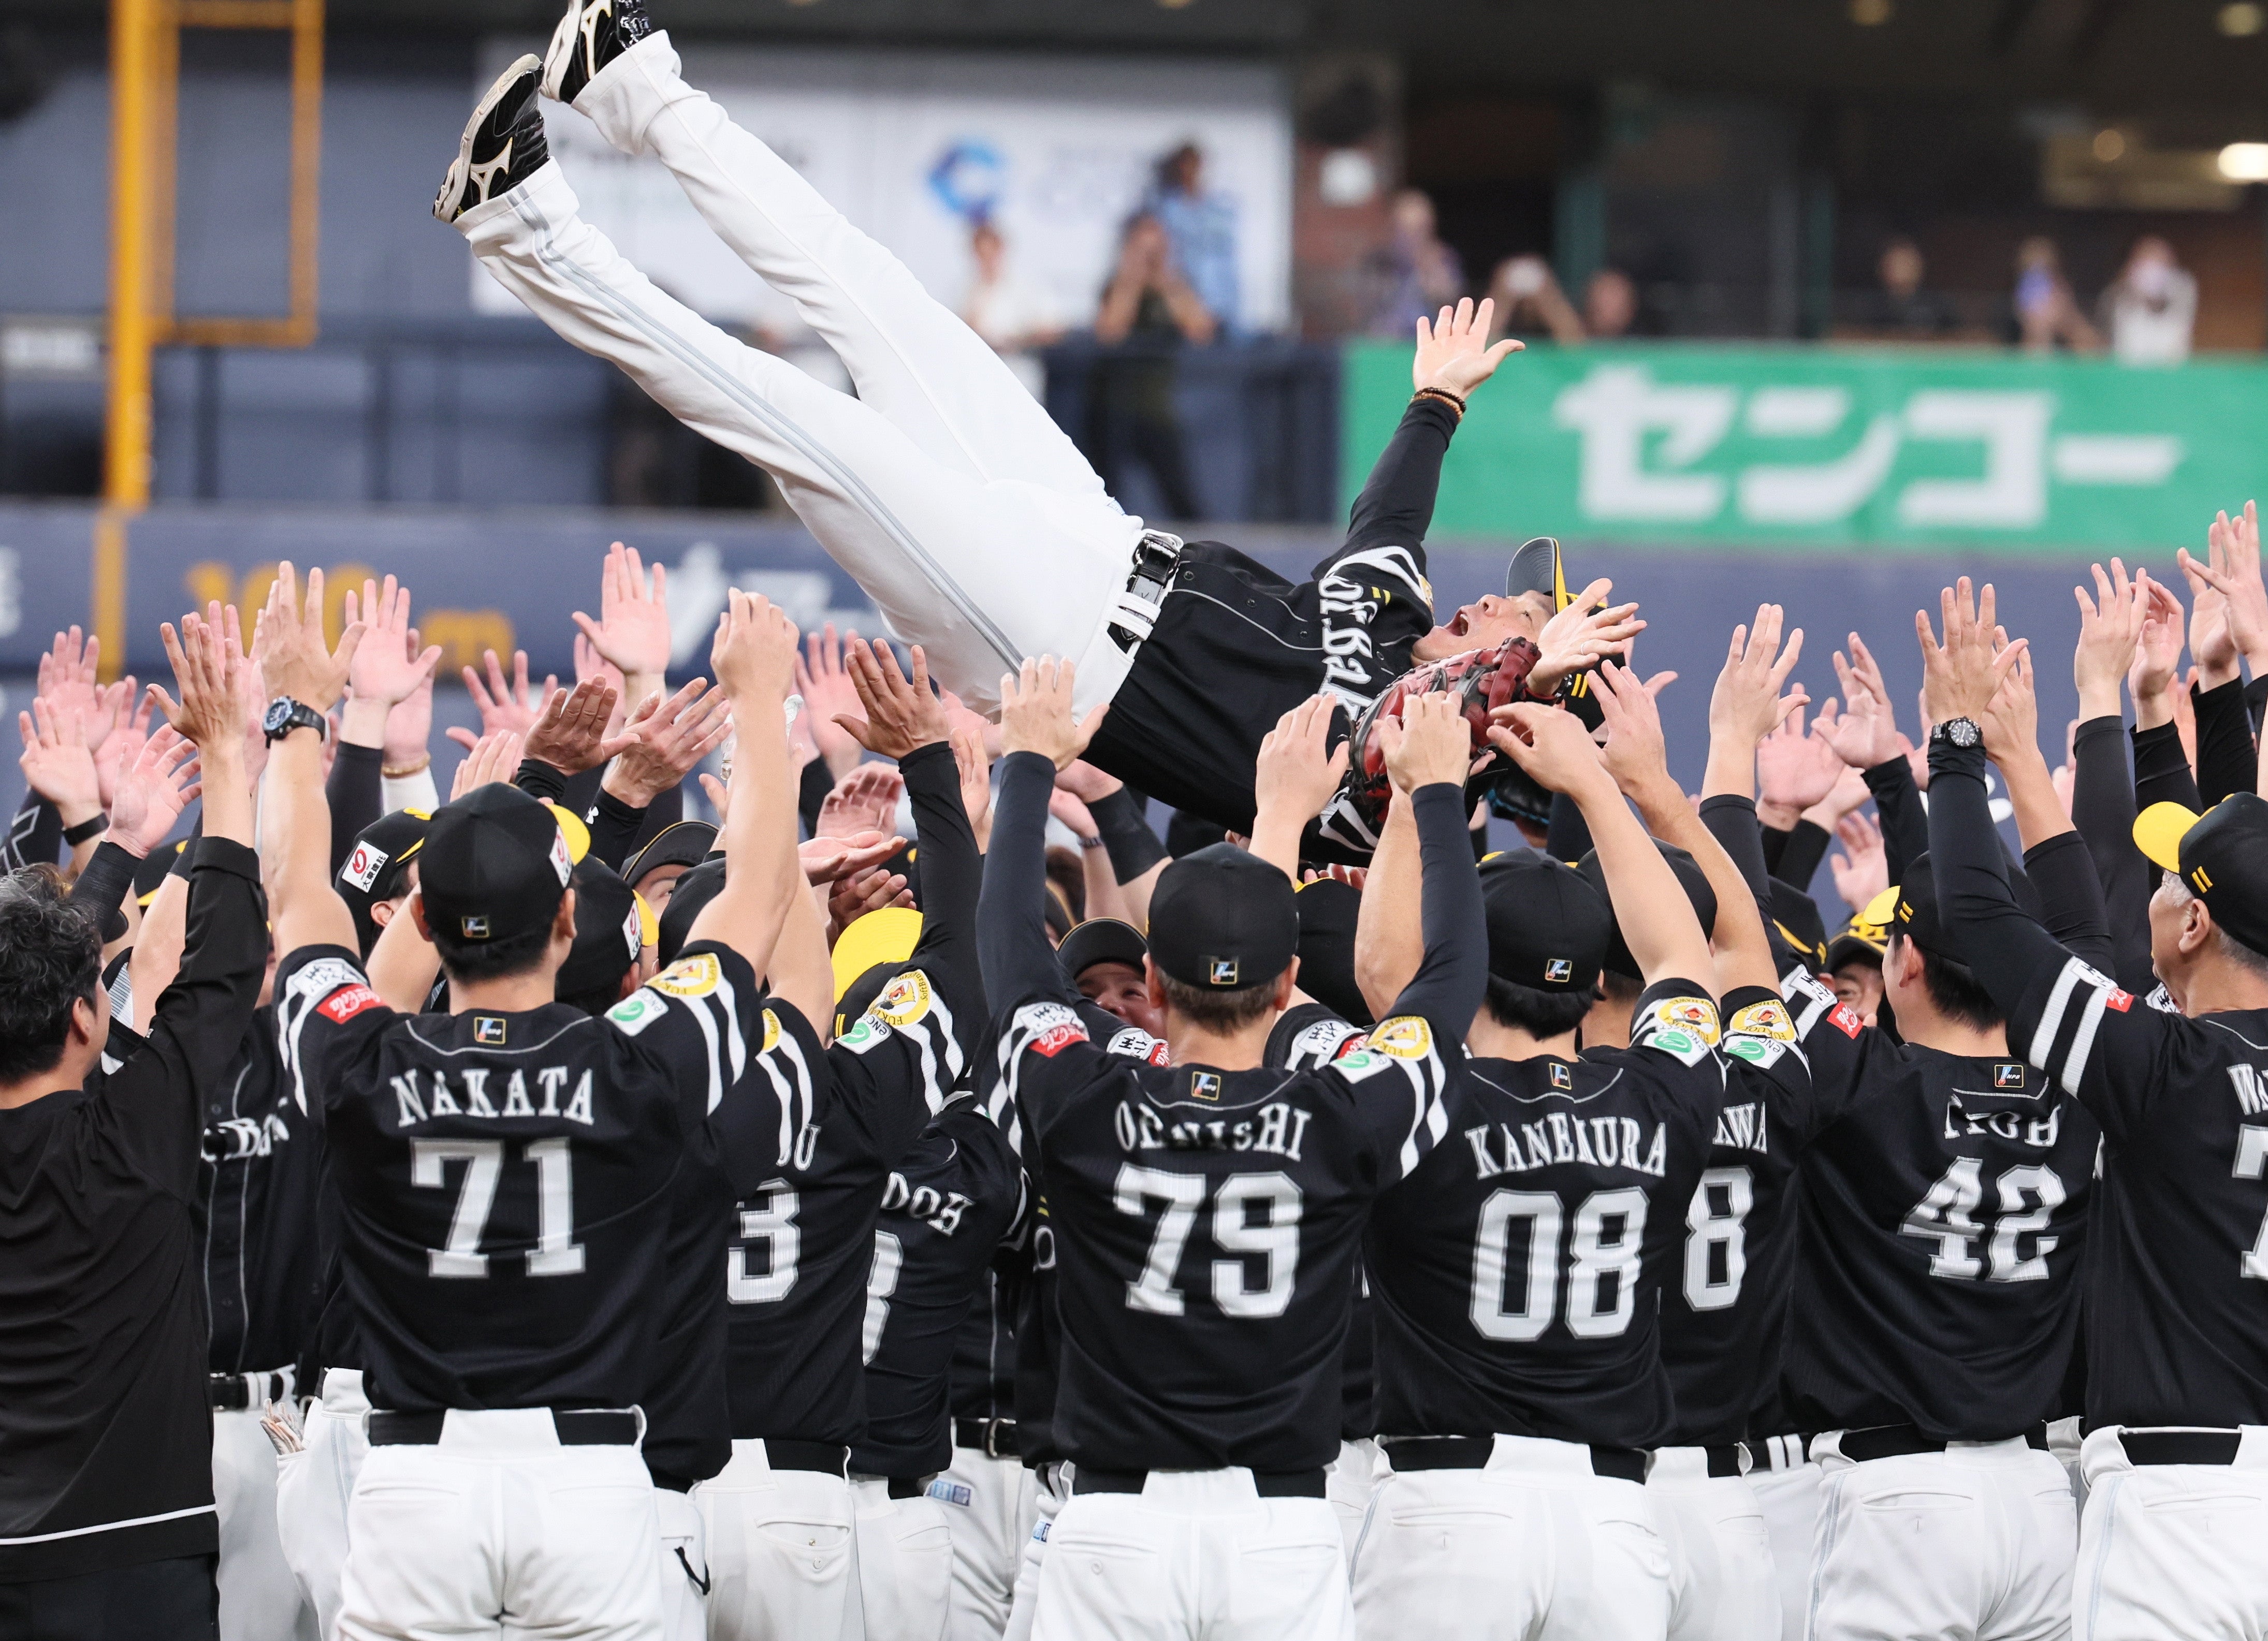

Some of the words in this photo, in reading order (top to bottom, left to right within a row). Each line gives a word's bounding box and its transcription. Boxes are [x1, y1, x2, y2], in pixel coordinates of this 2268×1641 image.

[1558, 364, 2183, 528] センコー
[389, 1065, 594, 1127] NAKATA
[409, 1136, 586, 1279] 71
[1112, 1161, 1304, 1320] 79
[1468, 1185, 1651, 1343] 08
[1897, 1155, 2068, 1283] 42
